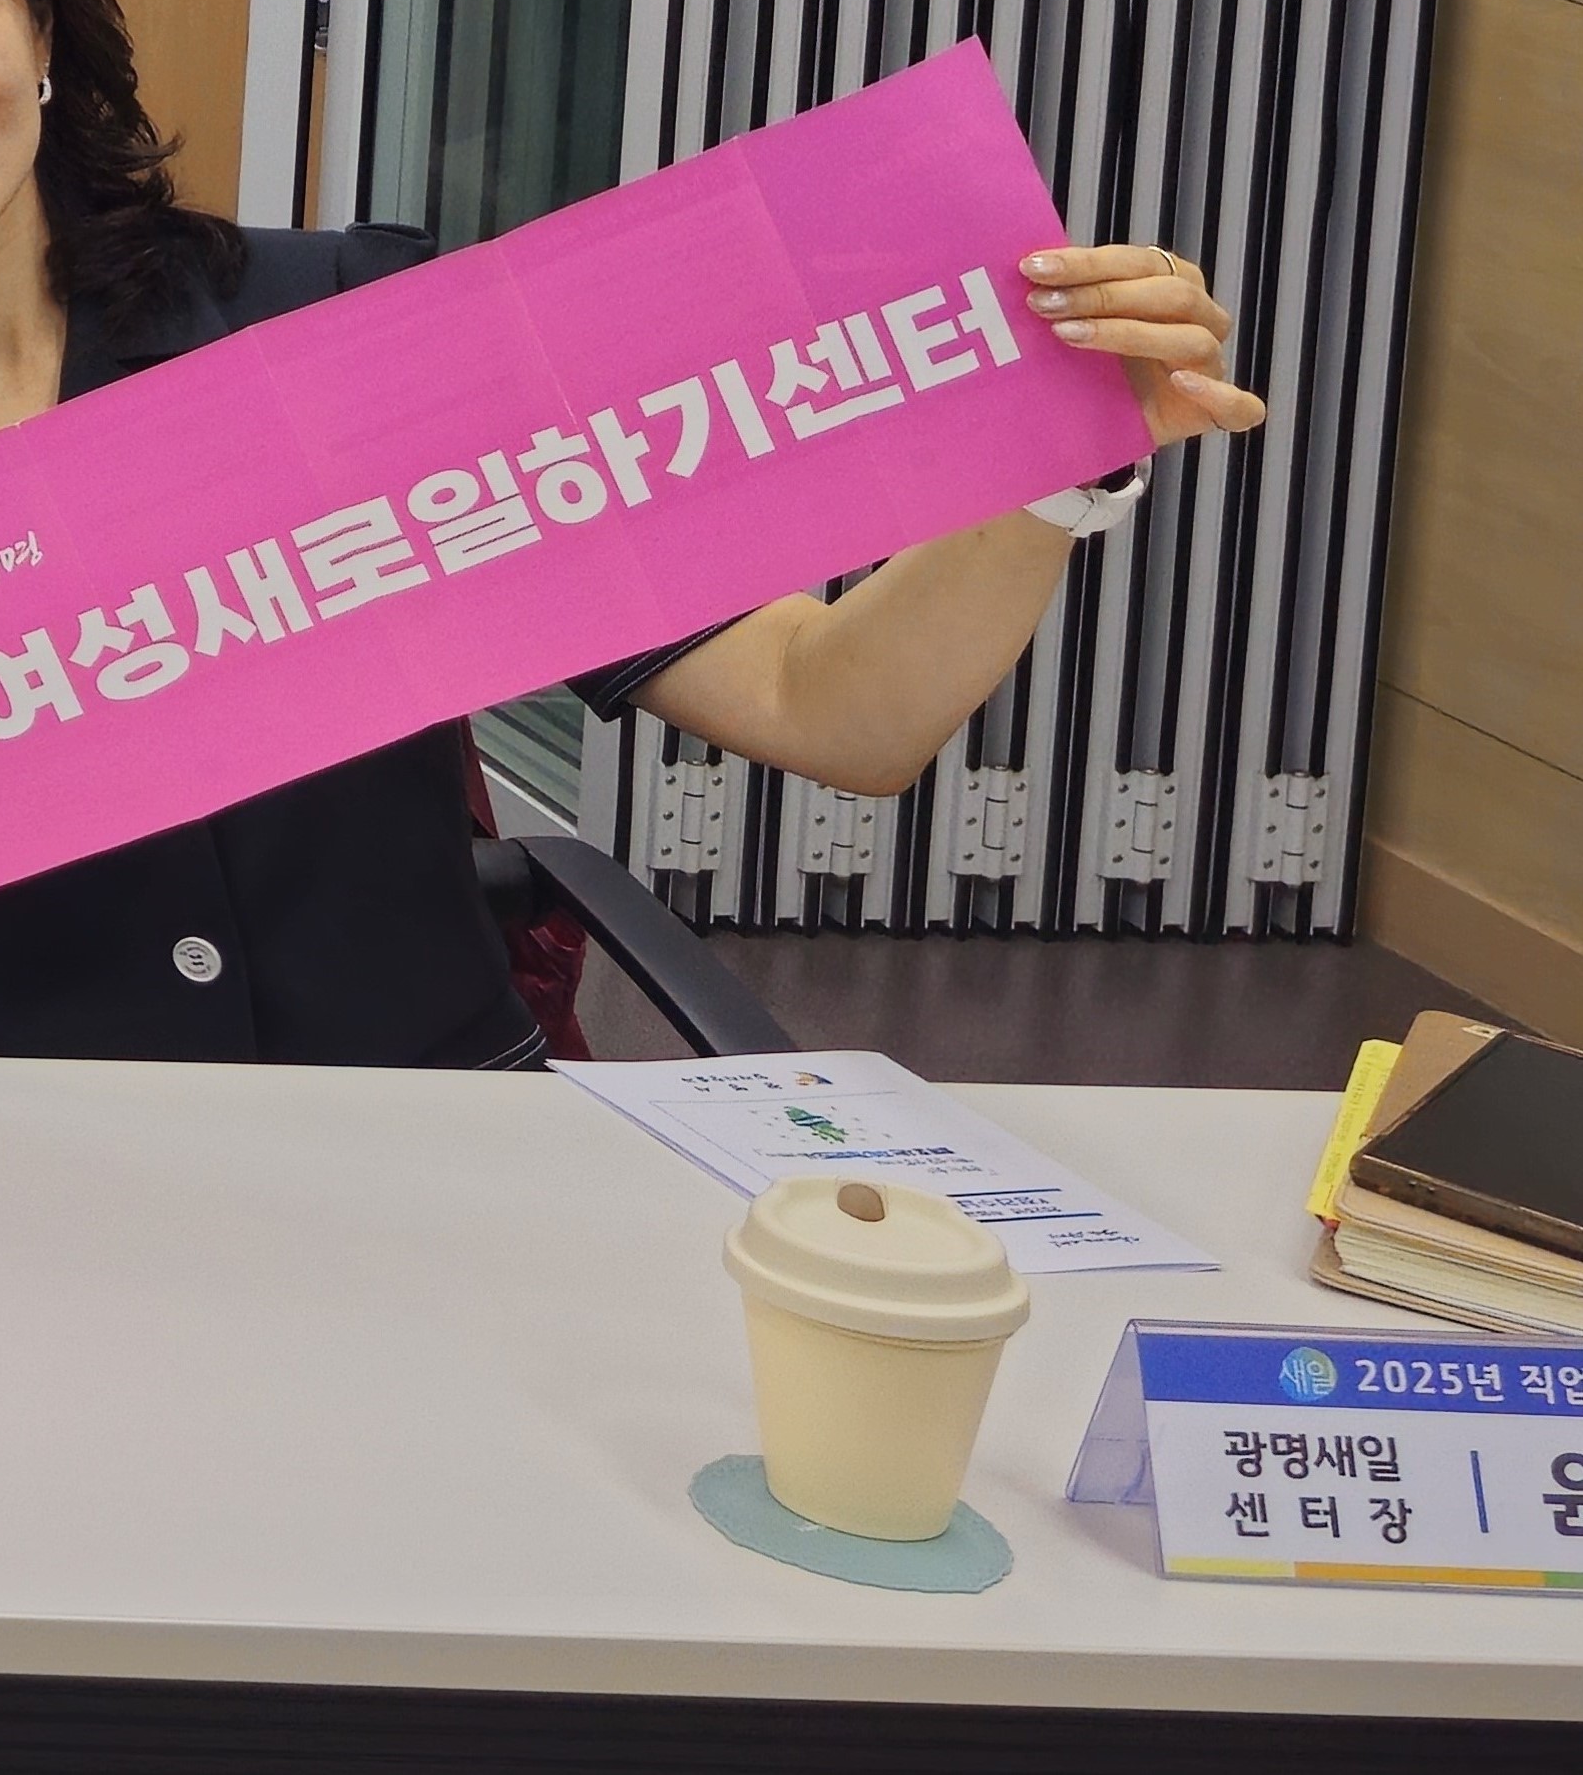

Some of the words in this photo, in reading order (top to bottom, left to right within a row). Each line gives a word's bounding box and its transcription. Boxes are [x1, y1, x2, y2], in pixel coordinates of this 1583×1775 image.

[1356, 1360, 1504, 1401] 2025년
[1224, 1432, 1400, 1482] 광명새일
[1226, 1493, 1412, 1544] 센터장
